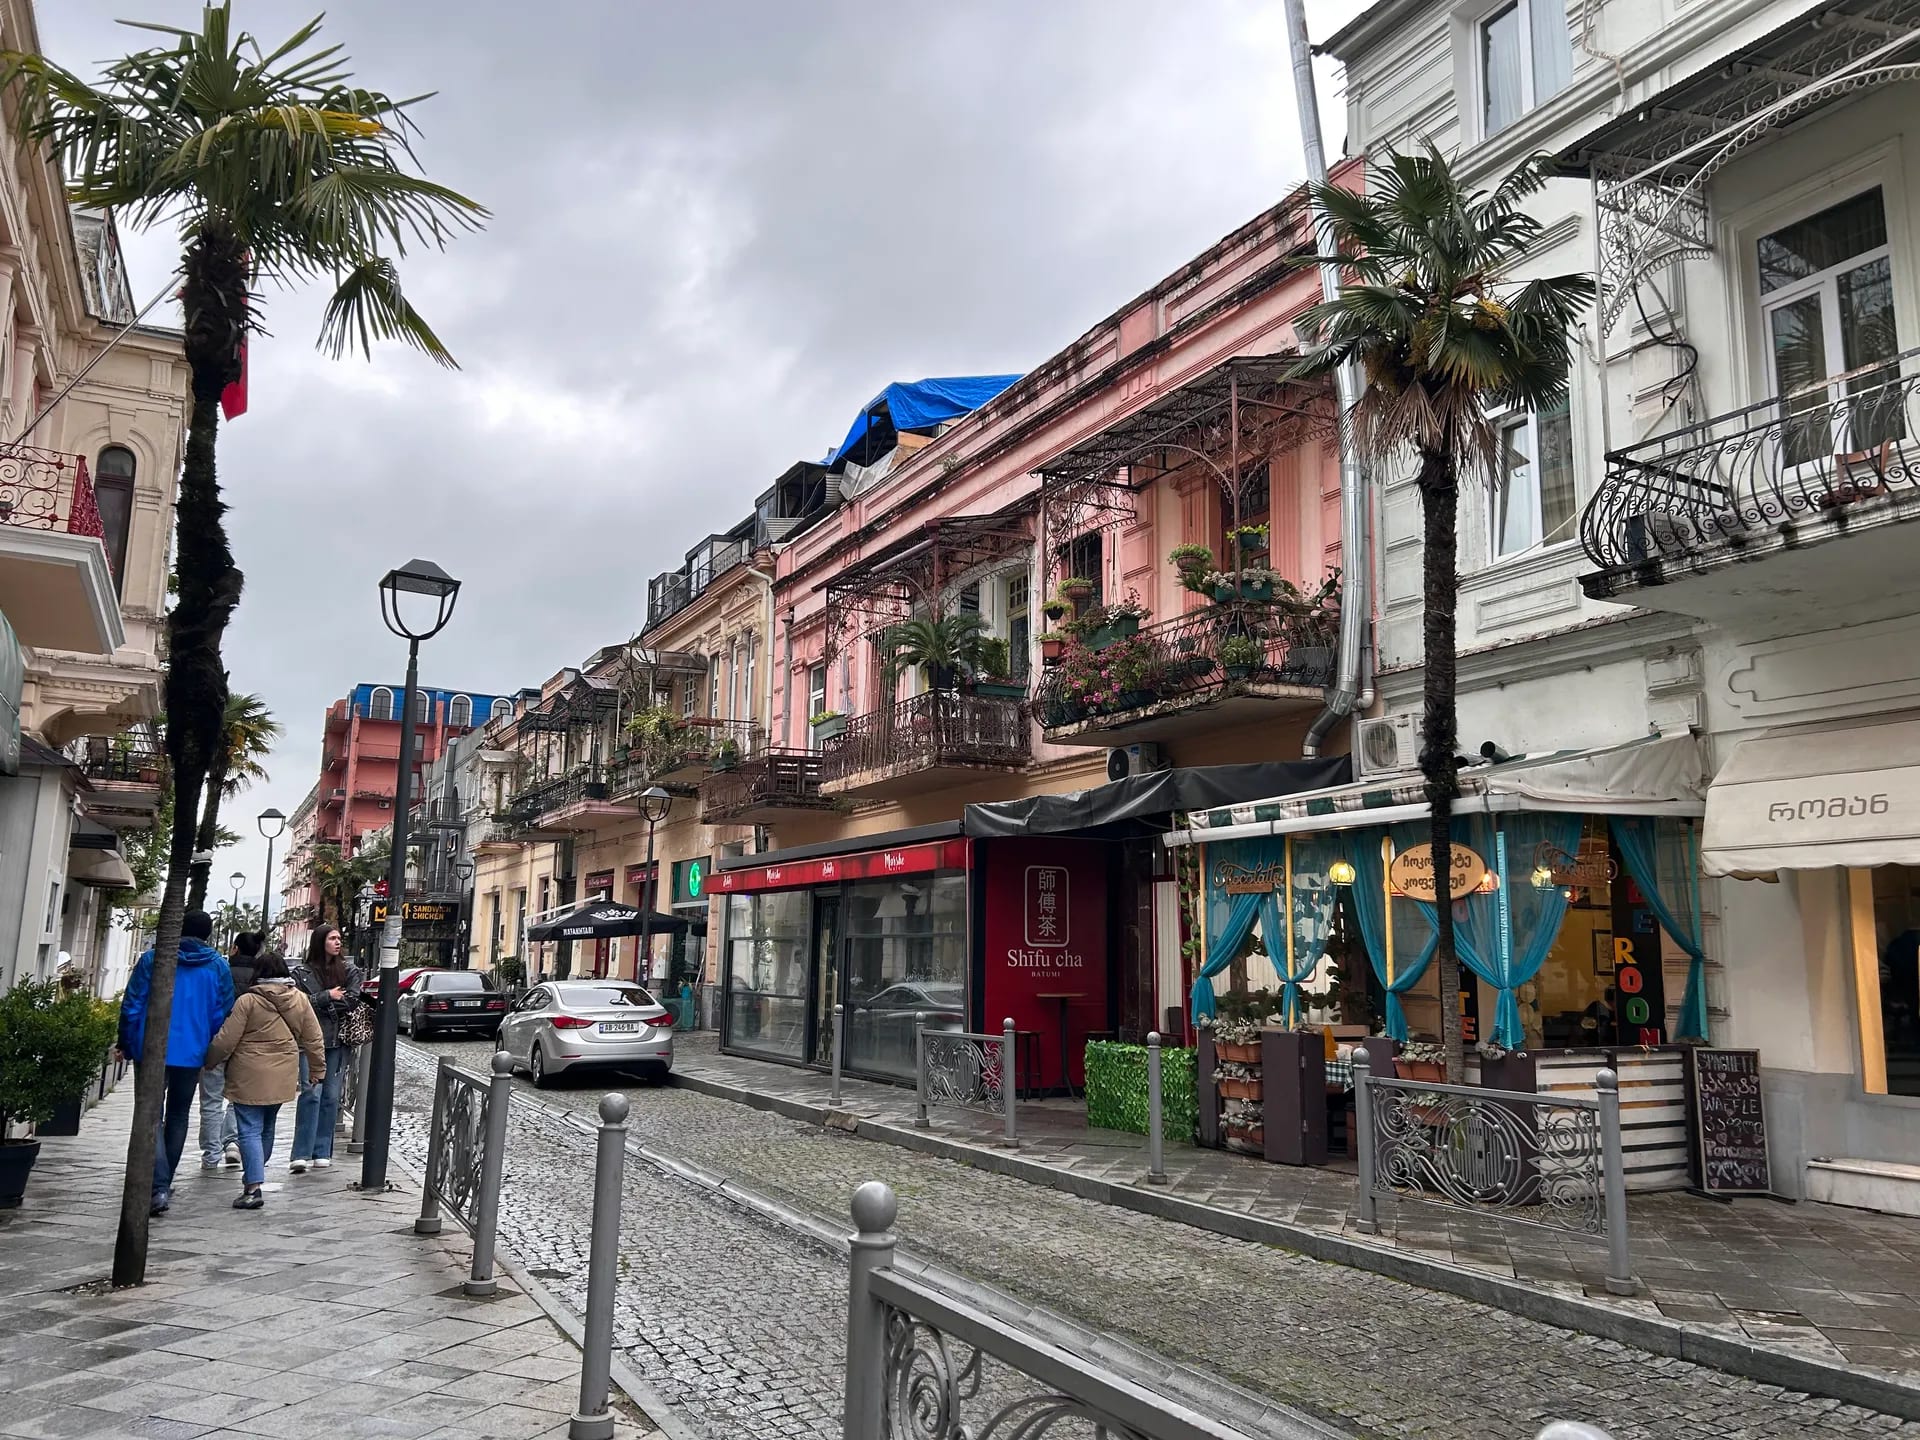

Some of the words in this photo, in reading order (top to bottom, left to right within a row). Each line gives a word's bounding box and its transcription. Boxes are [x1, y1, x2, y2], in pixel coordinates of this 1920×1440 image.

[1768, 793, 1889, 821] რომან
[1403, 853, 1472, 870] ჩოკოტე
[1403, 873, 1466, 890] კოფეუმ
[1038, 869, 1057, 937] 師傅茶
[1007, 949, 1051, 967] Shīfu
[1056, 950, 1083, 967] cha
[1702, 1097, 1760, 1115] WAFFLE
